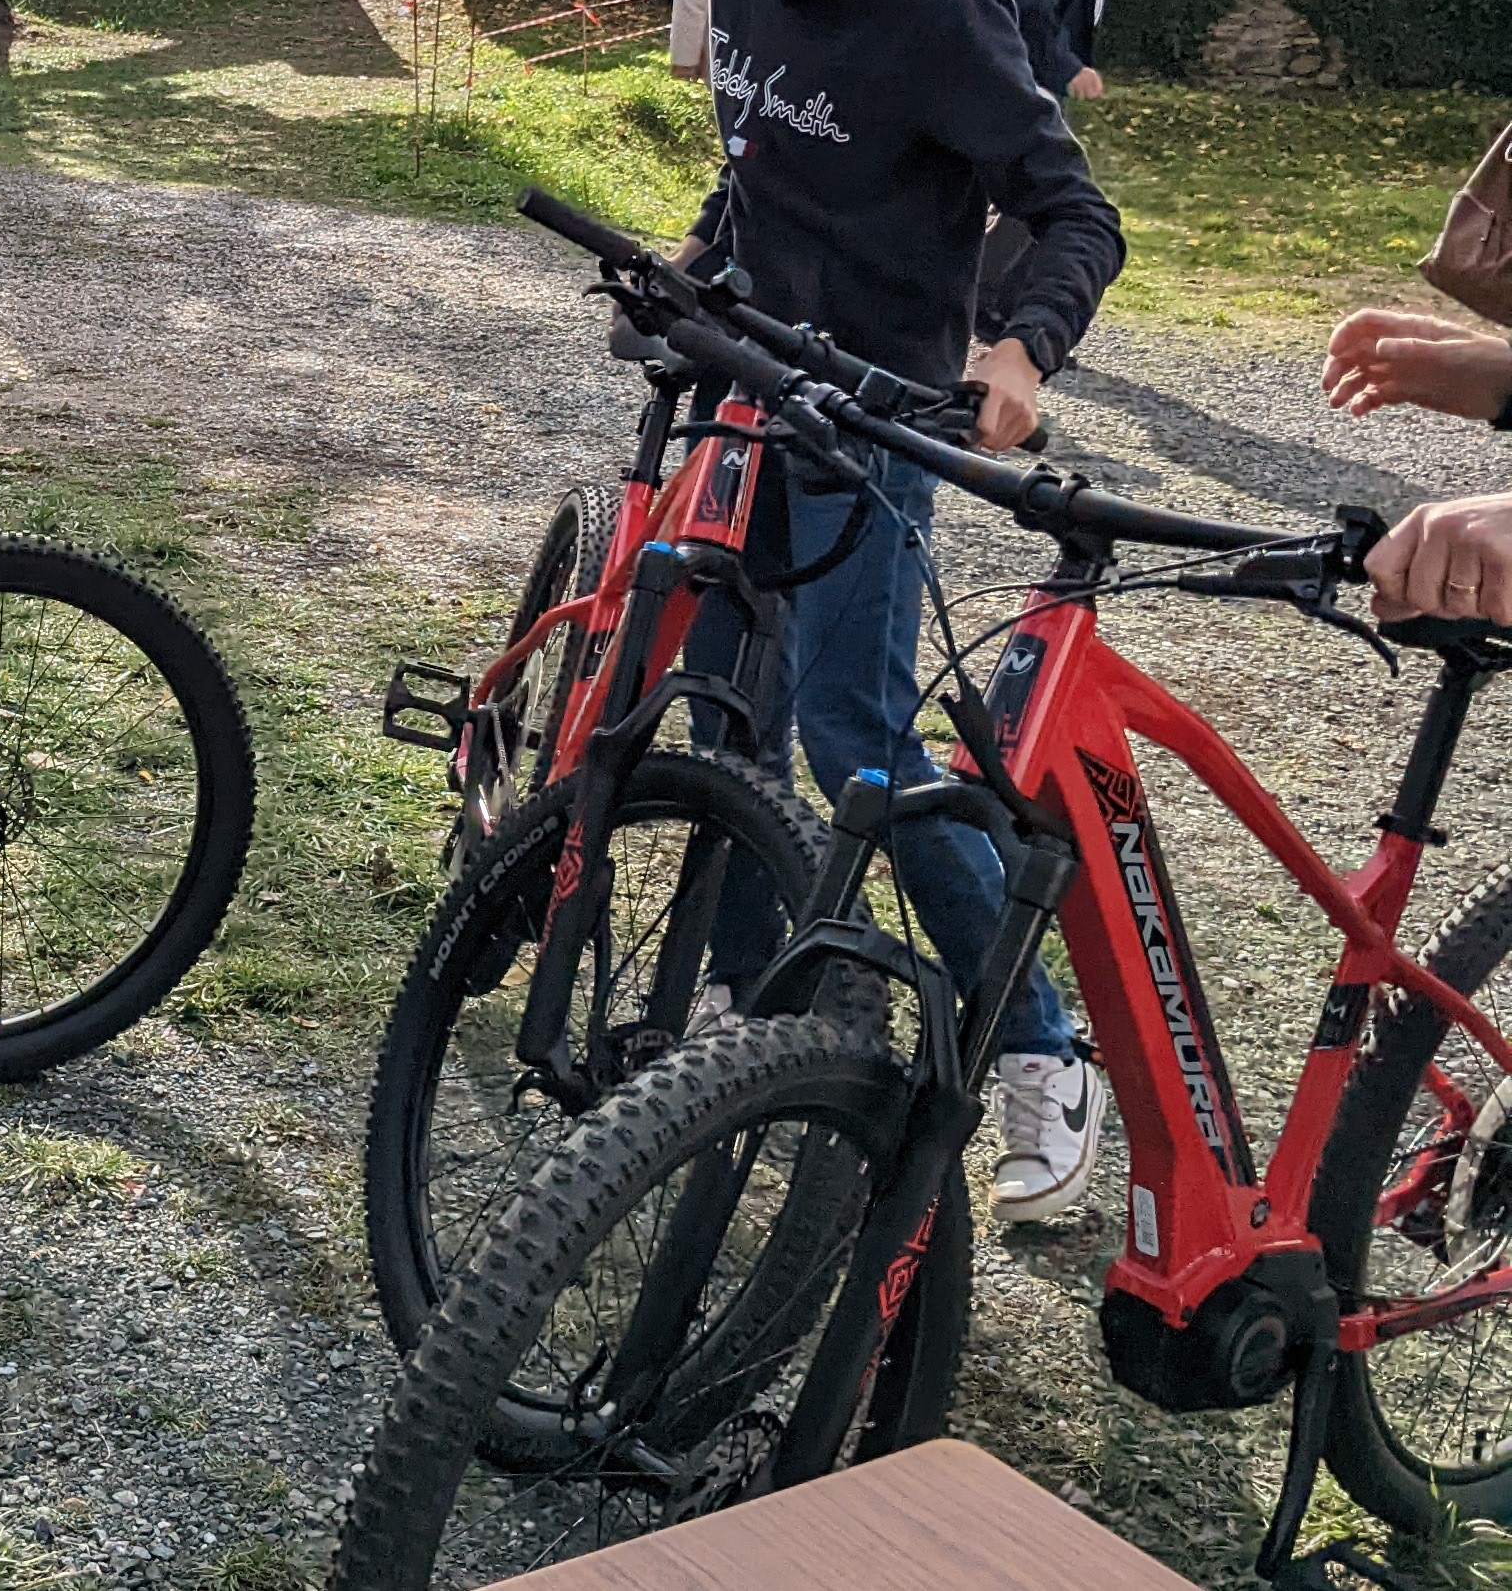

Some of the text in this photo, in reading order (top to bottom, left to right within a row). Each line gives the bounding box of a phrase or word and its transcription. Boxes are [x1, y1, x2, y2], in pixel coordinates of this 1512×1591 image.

[711, 28, 850, 143] Teddy Smith
[429, 892, 477, 981] MOUNT
